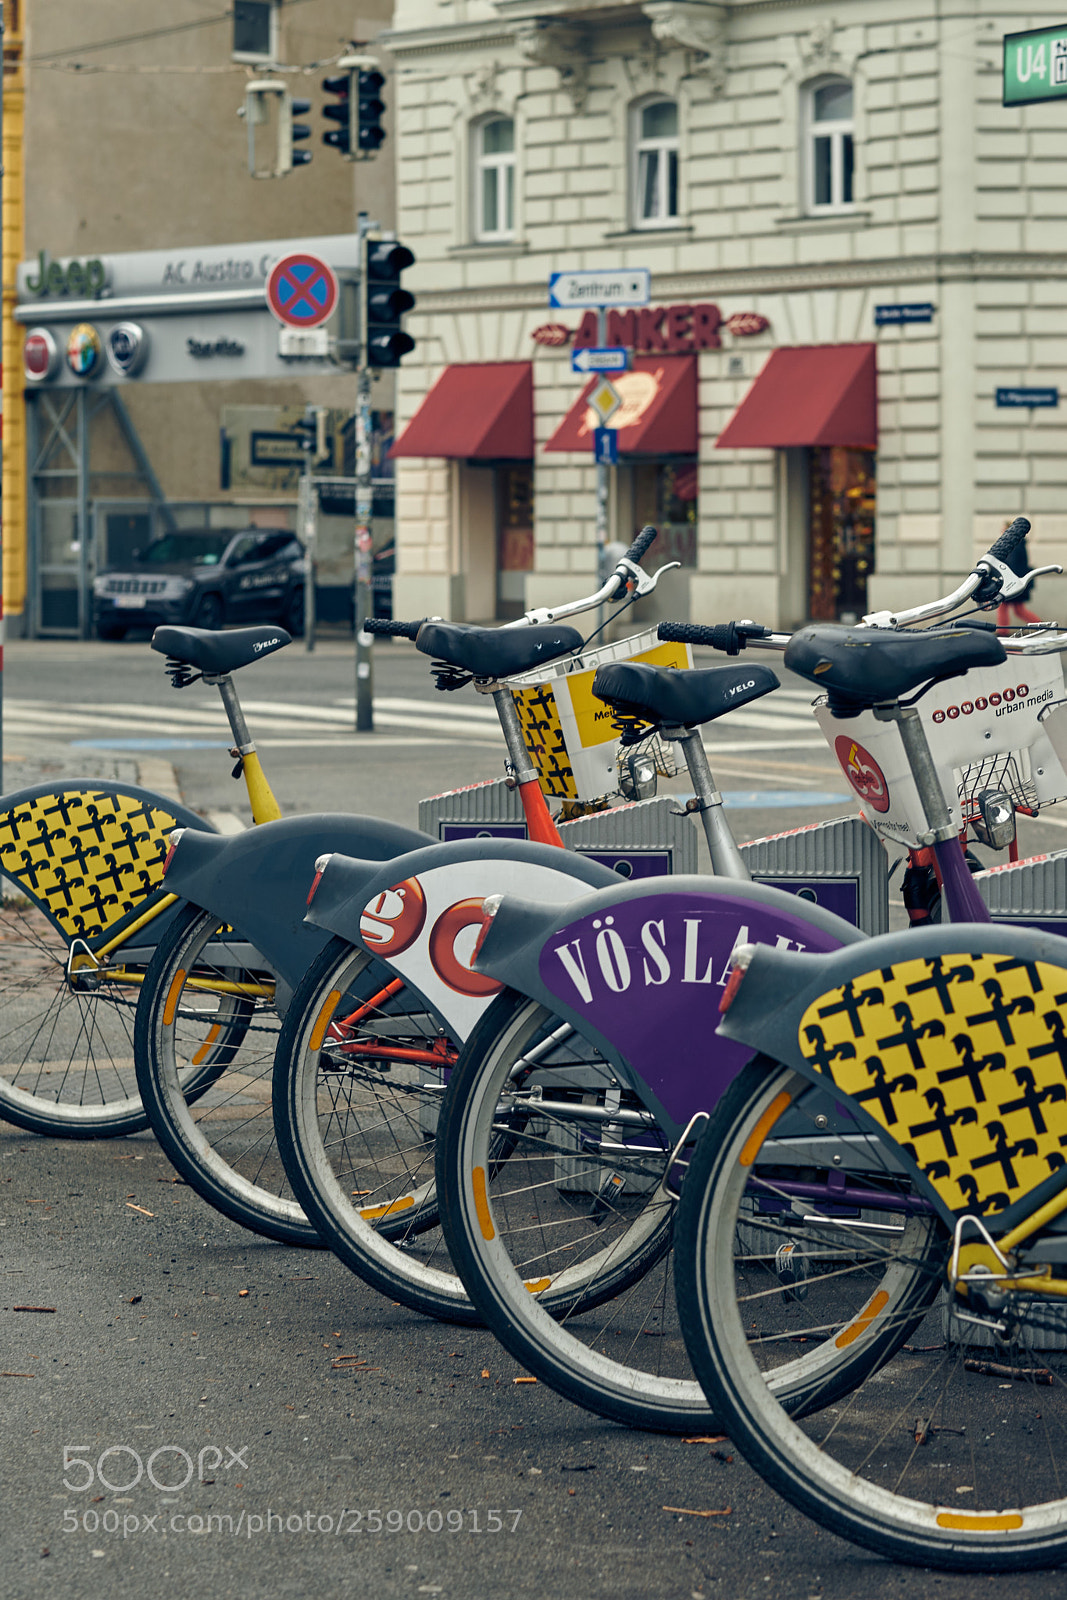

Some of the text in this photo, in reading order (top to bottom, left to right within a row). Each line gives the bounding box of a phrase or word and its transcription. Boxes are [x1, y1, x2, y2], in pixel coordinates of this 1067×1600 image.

[1017, 44, 1047, 83] U4
[25, 250, 105, 299] Jeep
[162, 261, 186, 284] AC
[191, 258, 254, 282] Austro
[569, 281, 623, 299] Zentrum
[573, 304, 722, 351] ANKER
[254, 637, 280, 653] VELO
[729, 679, 756, 697] VELO
[932, 683, 1030, 724] gewista
[995, 689, 1054, 717] urban media
